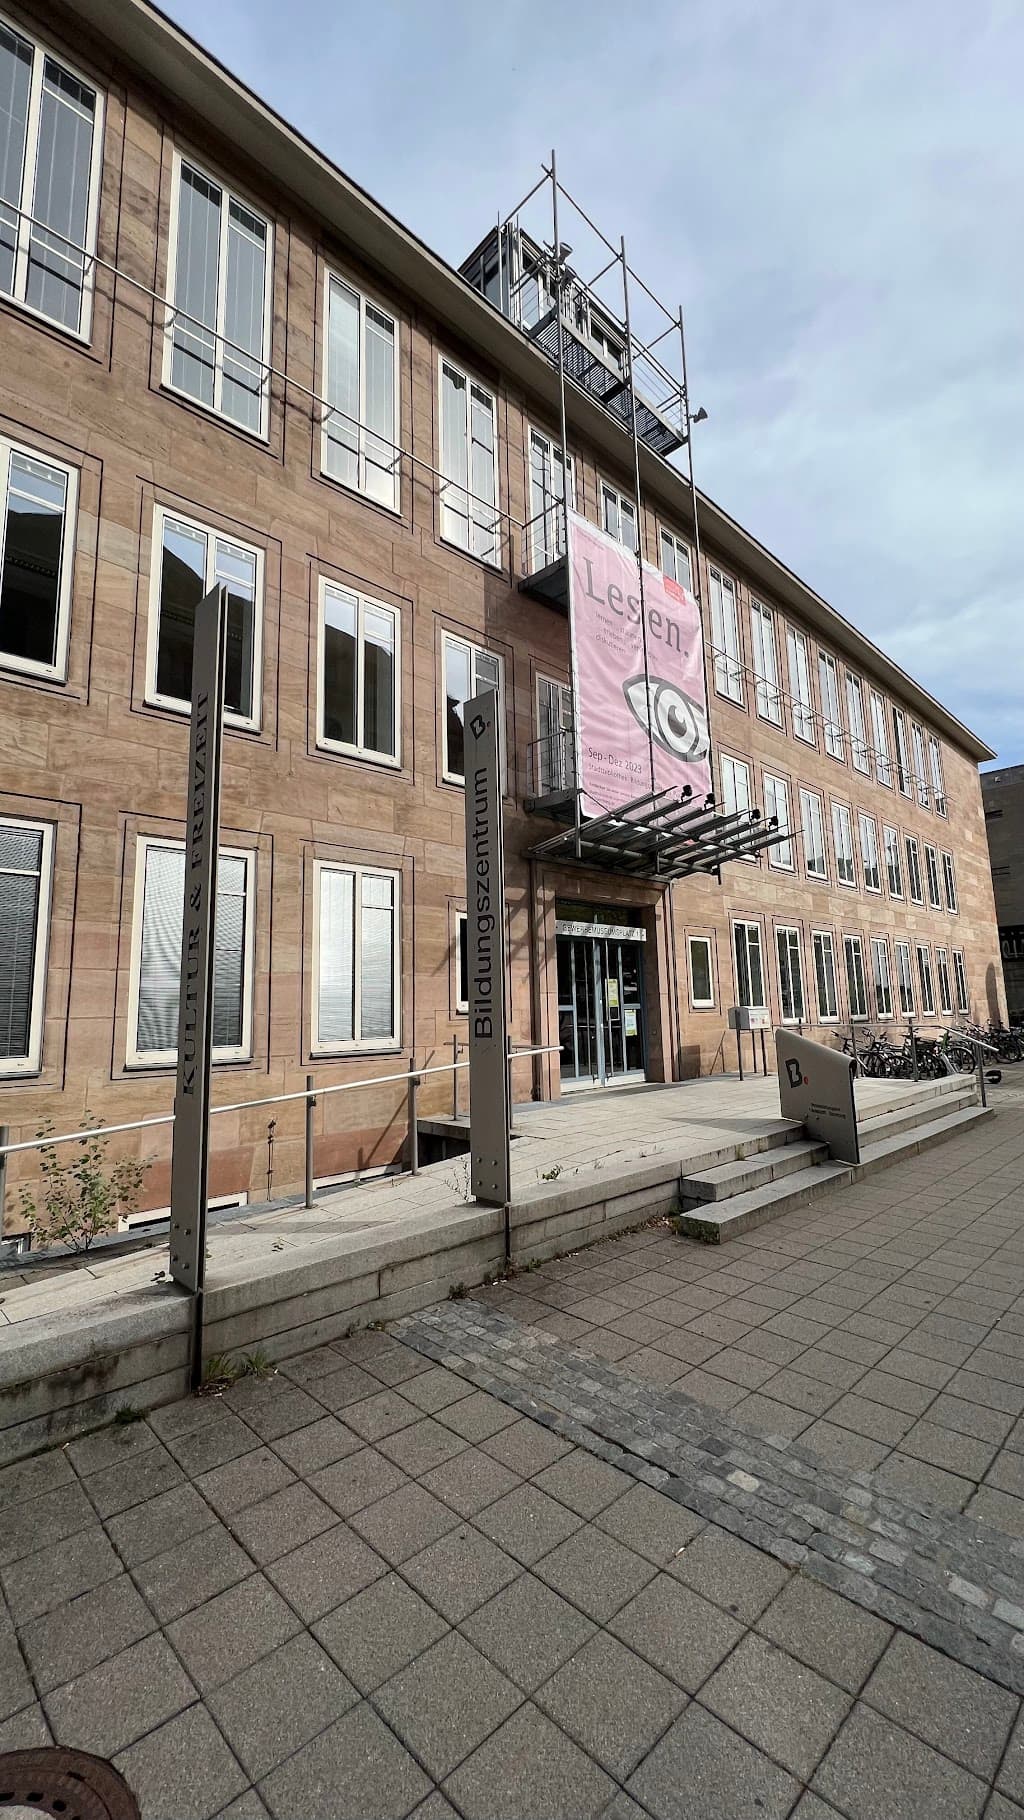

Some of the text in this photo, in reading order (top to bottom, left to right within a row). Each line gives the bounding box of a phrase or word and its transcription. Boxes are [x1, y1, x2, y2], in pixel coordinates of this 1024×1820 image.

[182, 692, 209, 1096] KULTUR & FREIZEIT
[472, 767, 495, 1039] Bildungszentrum
[625, 760, 642, 774] 2023
